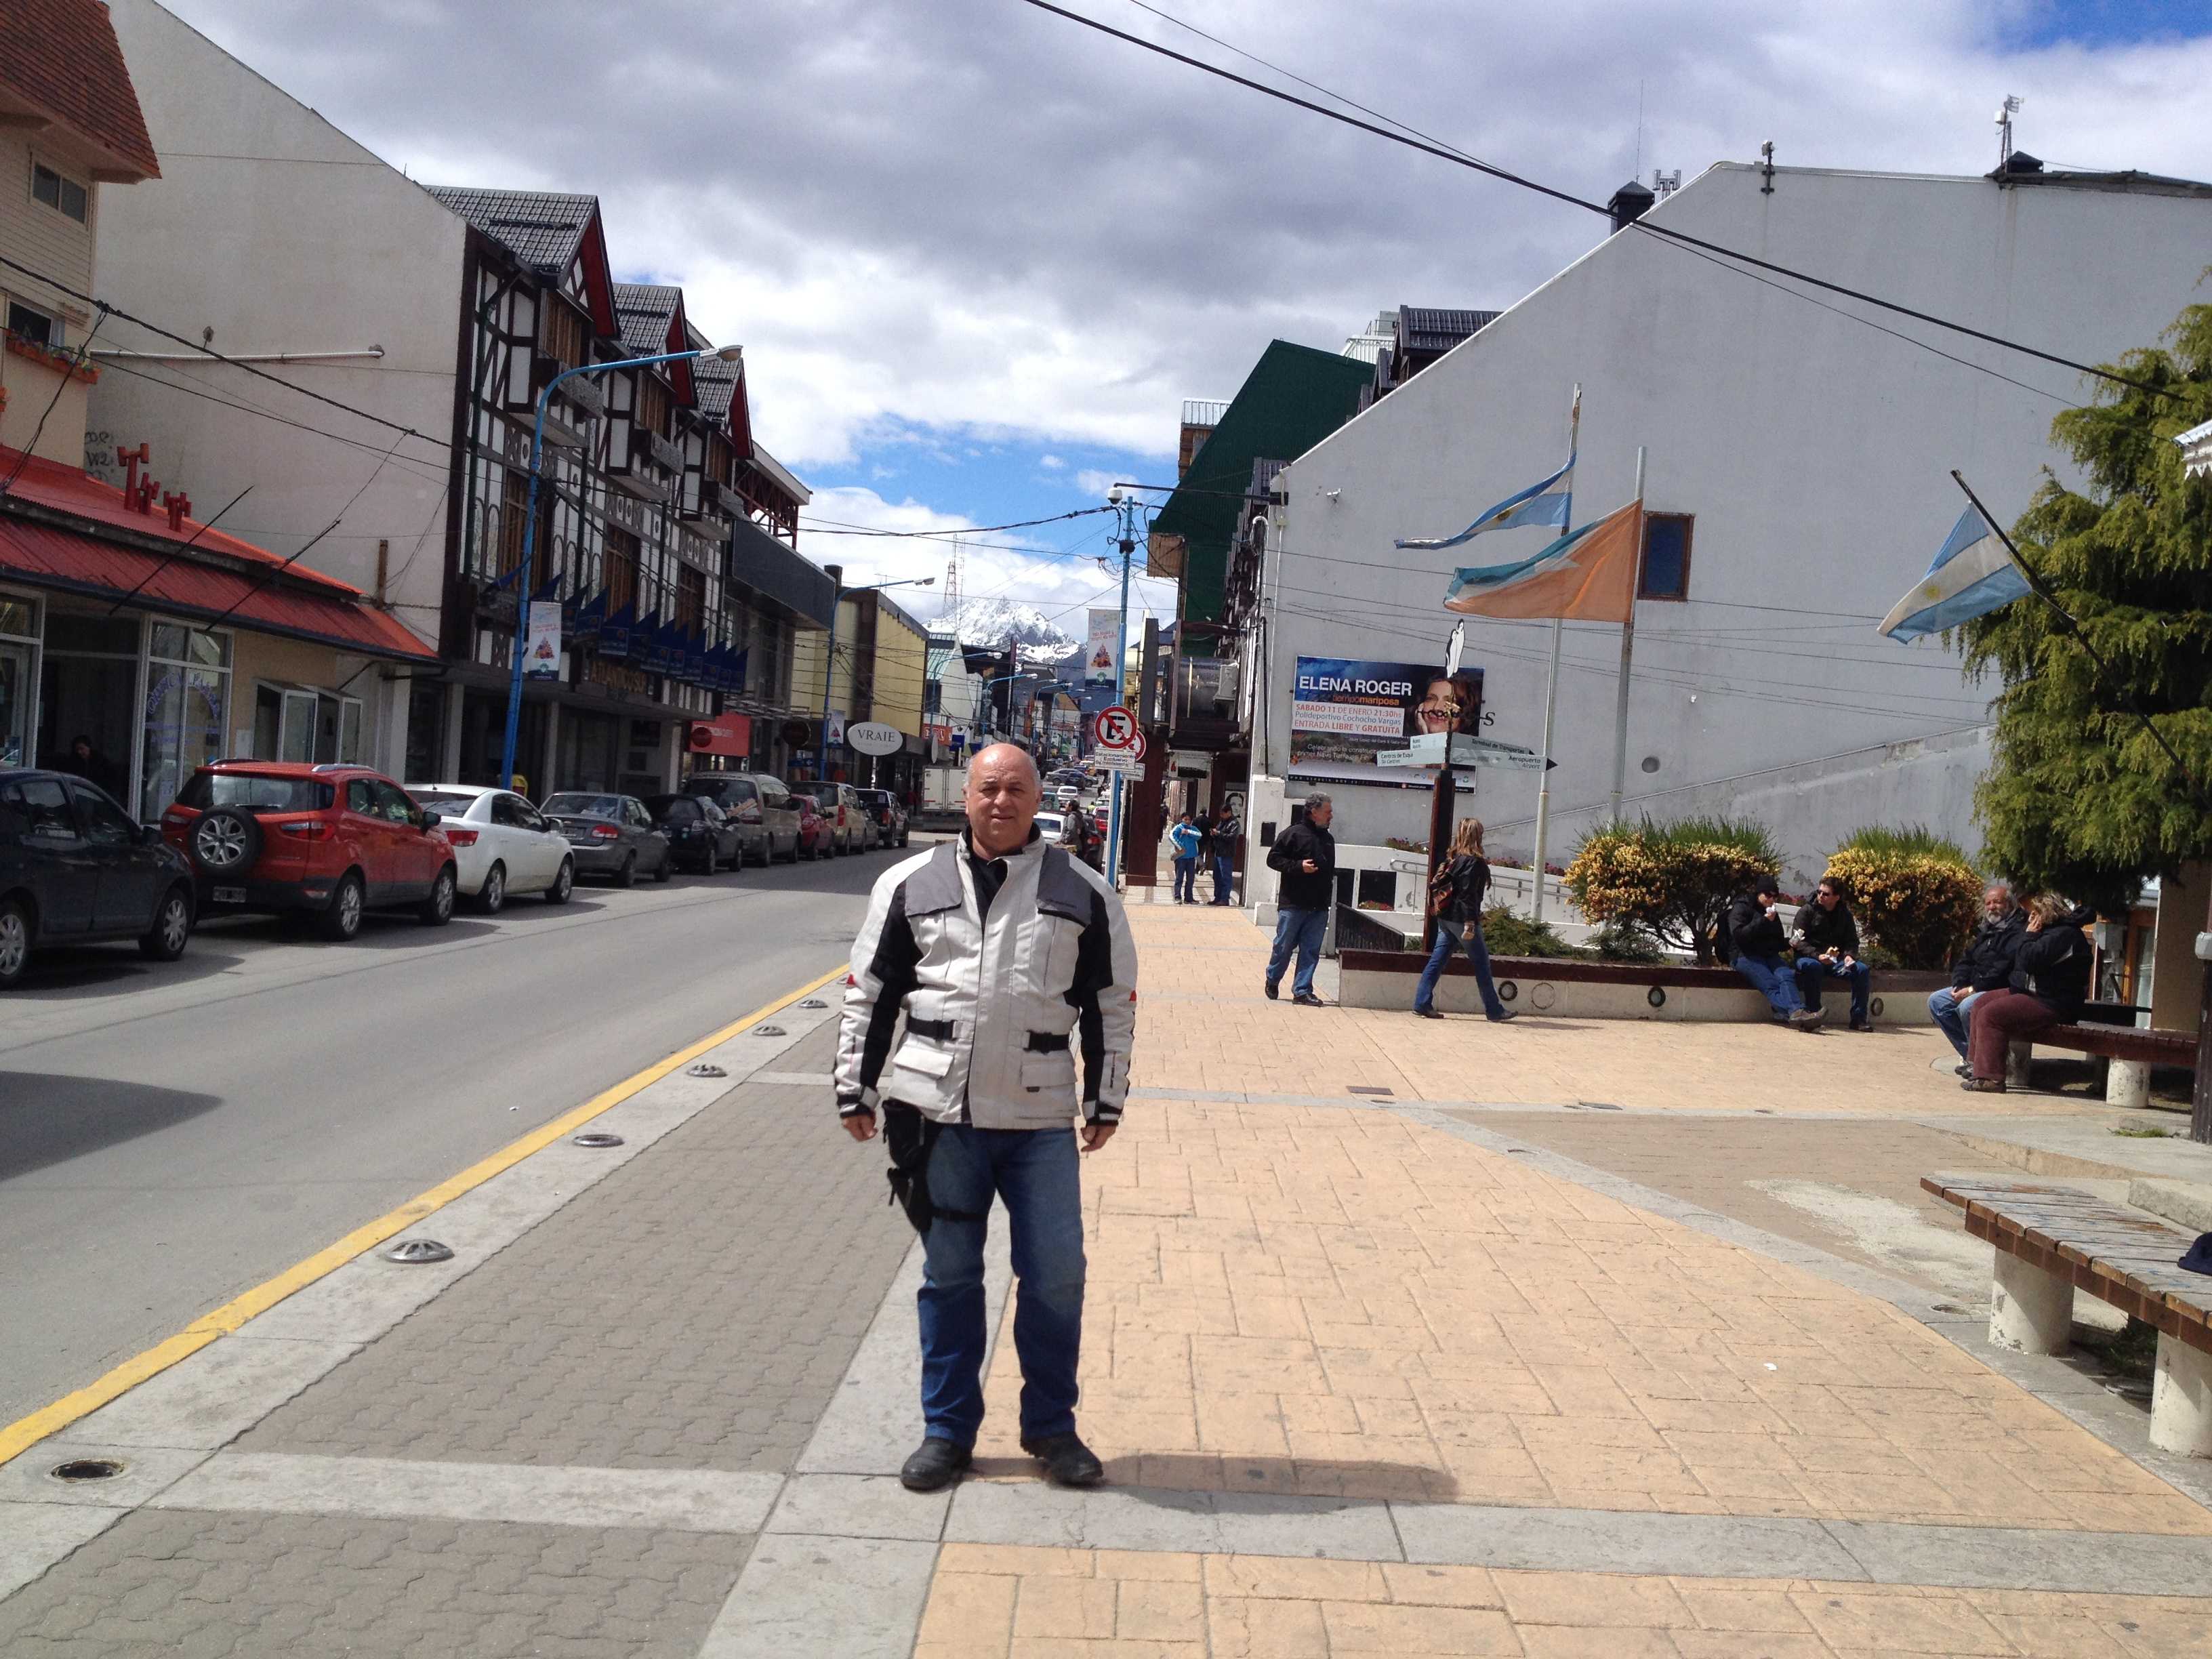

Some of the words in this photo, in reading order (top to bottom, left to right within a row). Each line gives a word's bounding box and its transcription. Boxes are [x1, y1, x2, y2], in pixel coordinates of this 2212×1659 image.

[1299, 676, 1351, 693] ELENA
[1355, 680, 1412, 696] ROGER
[1296, 703, 1326, 713] SABADO
[1328, 705, 1335, 714] 11
[1349, 708, 1372, 716] ENERO
[1107, 716, 1126, 740] E
[1294, 720, 1330, 729] ENTRADA
[1332, 722, 1353, 731] LIBRE
[1361, 725, 1400, 735] GRATUITA
[1378, 717, 1401, 726] Vargas
[858, 729, 895, 742] VRAIE
[1509, 756, 1540, 764] Aeropuerto
